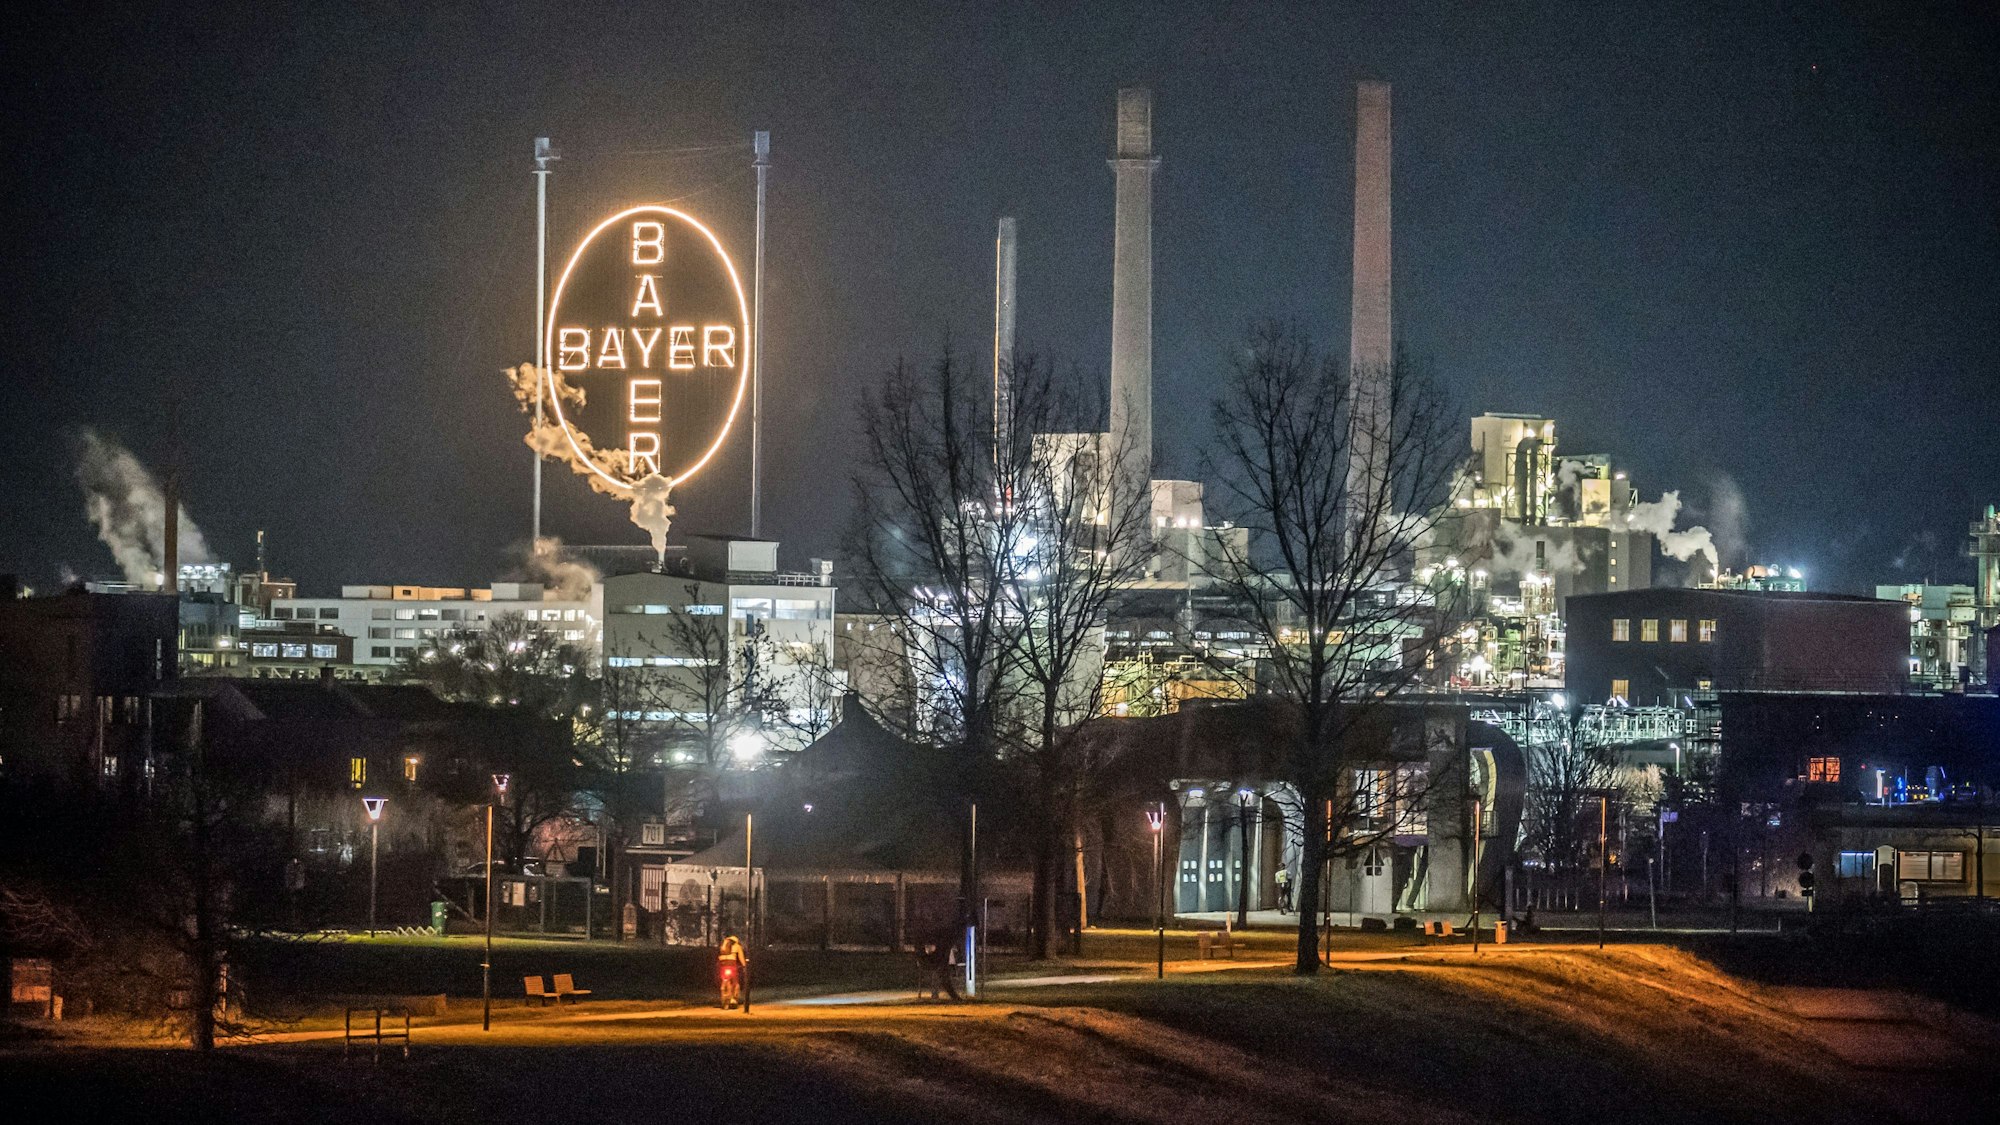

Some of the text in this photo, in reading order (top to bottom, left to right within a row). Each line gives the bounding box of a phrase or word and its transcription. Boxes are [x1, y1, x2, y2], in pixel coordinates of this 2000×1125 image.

[559, 325, 736, 370] BAYER
[629, 221, 665, 474] BAYER
[645, 826, 660, 841] 701
